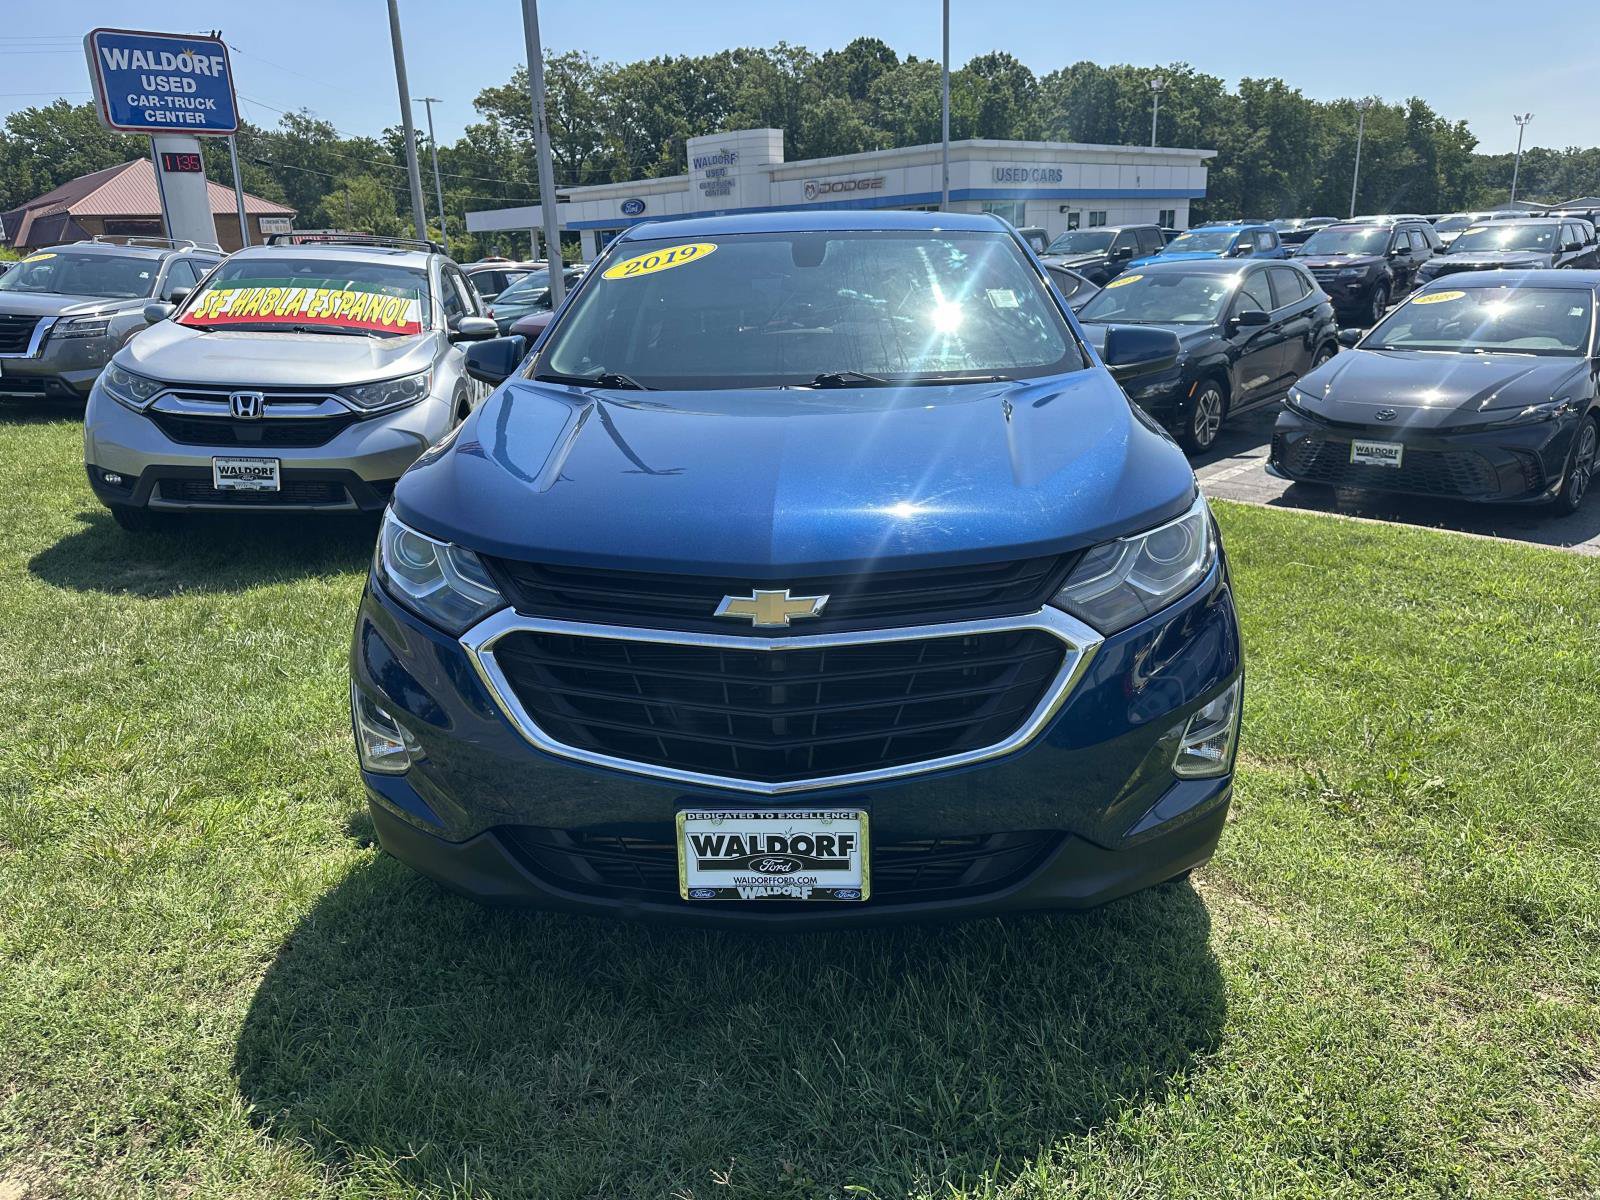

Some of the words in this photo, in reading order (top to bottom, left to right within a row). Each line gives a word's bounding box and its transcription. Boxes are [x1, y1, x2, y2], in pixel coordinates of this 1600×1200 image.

[102, 47, 225, 77] WALDORF
[140, 75, 197, 93] USED
[127, 94, 217, 110] CAR-TRUCK
[144, 110, 206, 124] CENTER
[693, 153, 737, 169] WALDORF
[705, 168, 726, 177] USED
[996, 167, 1029, 182] USED
[1032, 168, 1063, 182] CARS
[819, 177, 883, 194] DODGE
[624, 246, 698, 276] 2019
[193, 288, 232, 319] SE
[227, 287, 304, 318] HABLA
[1356, 446, 1399, 455] WALDORF
[218, 466, 275, 475] WALDORF
[687, 812, 757, 820] DEDICATED
[688, 833, 856, 857] WALDORF
[759, 858, 792, 872] Ford
[733, 876, 818, 884] WALDORFFORD.COM
[736, 886, 813, 900] WALDORF
